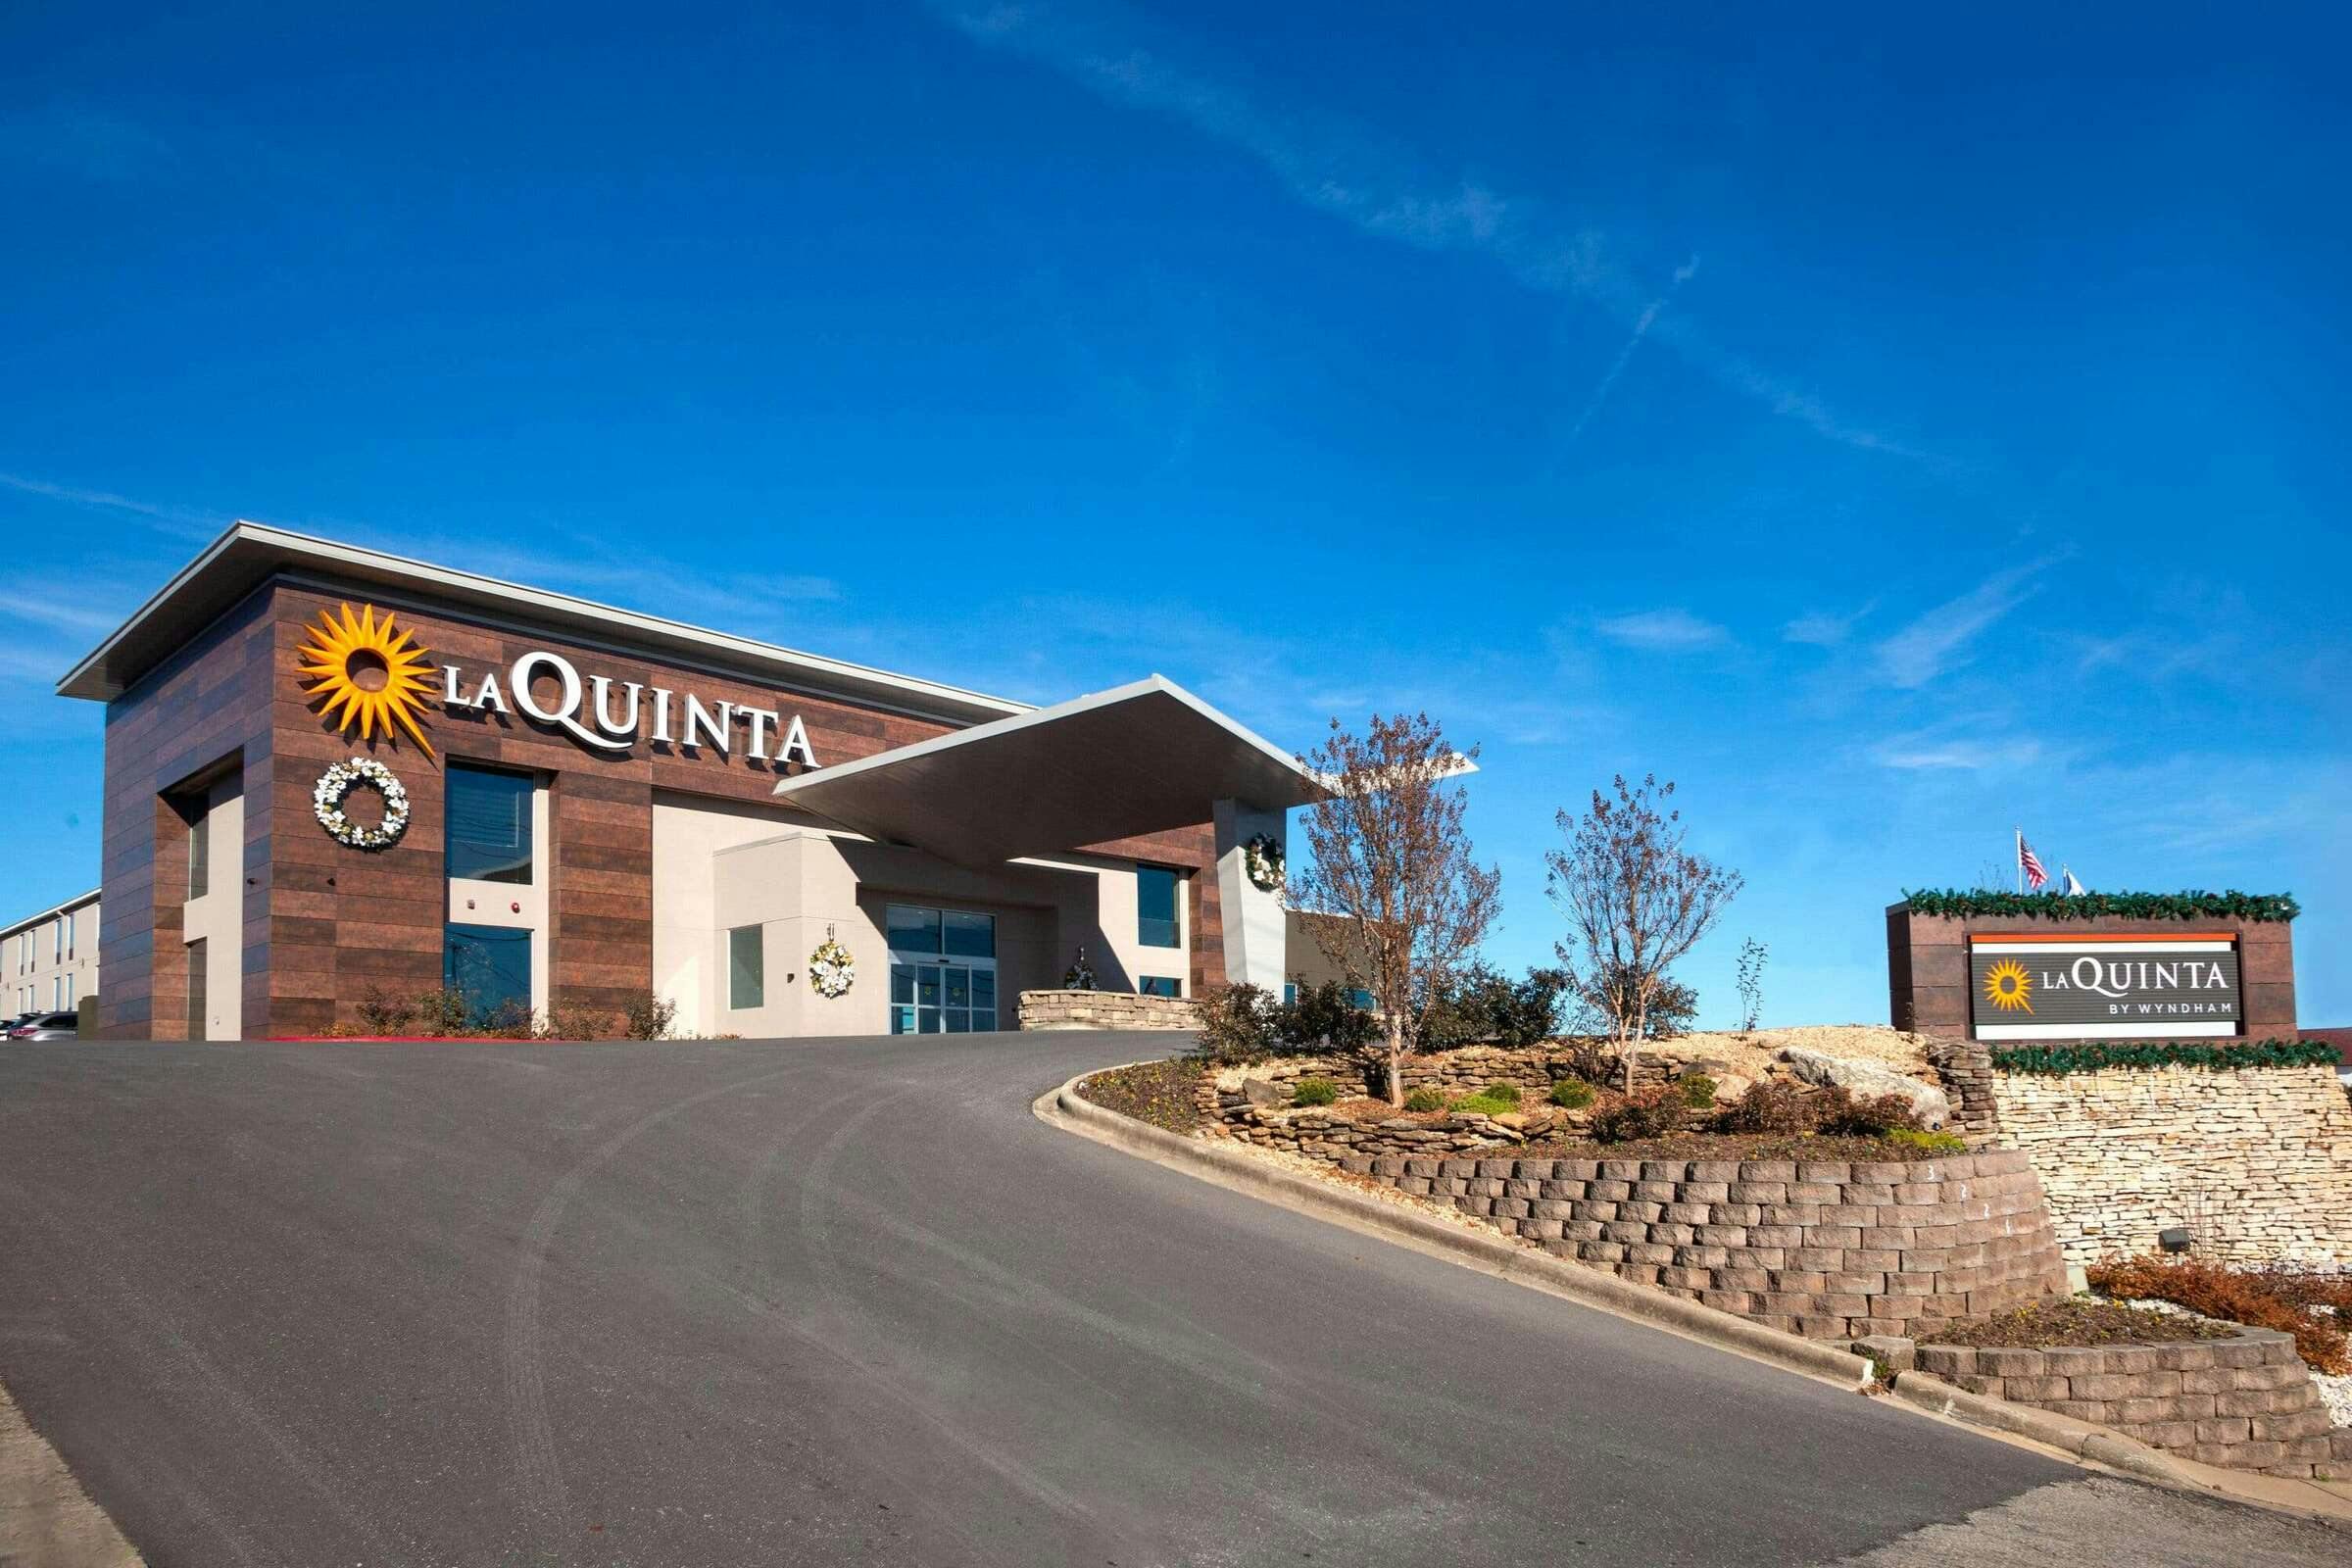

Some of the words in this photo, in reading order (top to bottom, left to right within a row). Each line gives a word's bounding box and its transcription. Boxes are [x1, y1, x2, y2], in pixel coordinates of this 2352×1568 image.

[440, 664, 511, 714] LA
[509, 651, 823, 769] QUINTA
[2042, 971, 2071, 990] LA
[2071, 956, 2230, 998] QUINTA
[2109, 1004, 2130, 1015] BY
[2139, 1003, 2232, 1014] WYNDHAM
